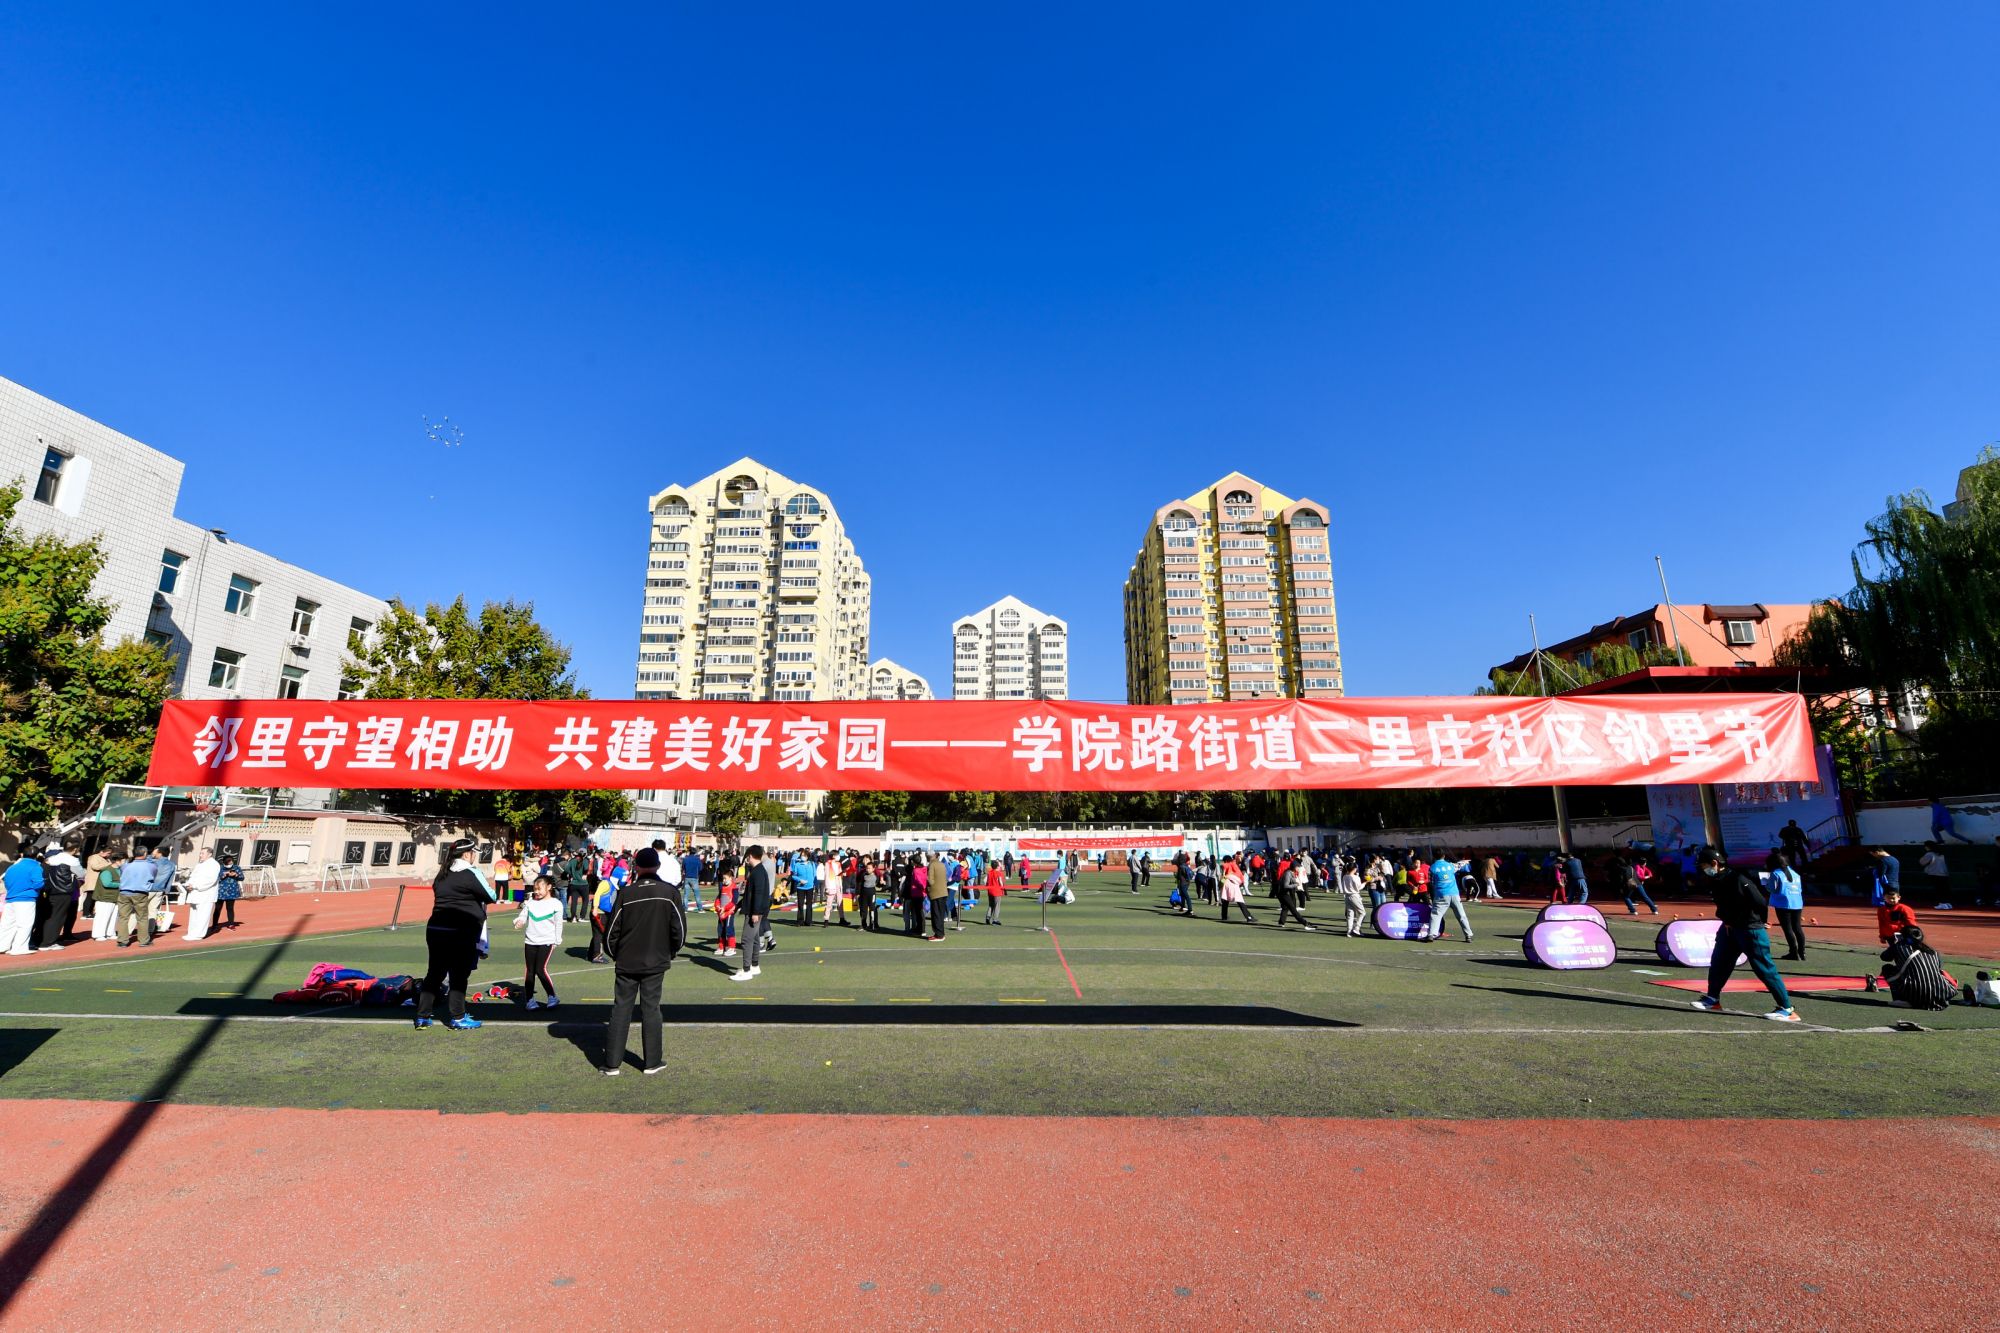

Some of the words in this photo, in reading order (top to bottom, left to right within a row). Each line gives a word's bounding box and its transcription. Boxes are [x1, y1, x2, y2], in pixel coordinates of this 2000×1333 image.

[192, 715, 513, 771] 邻里守望相助
